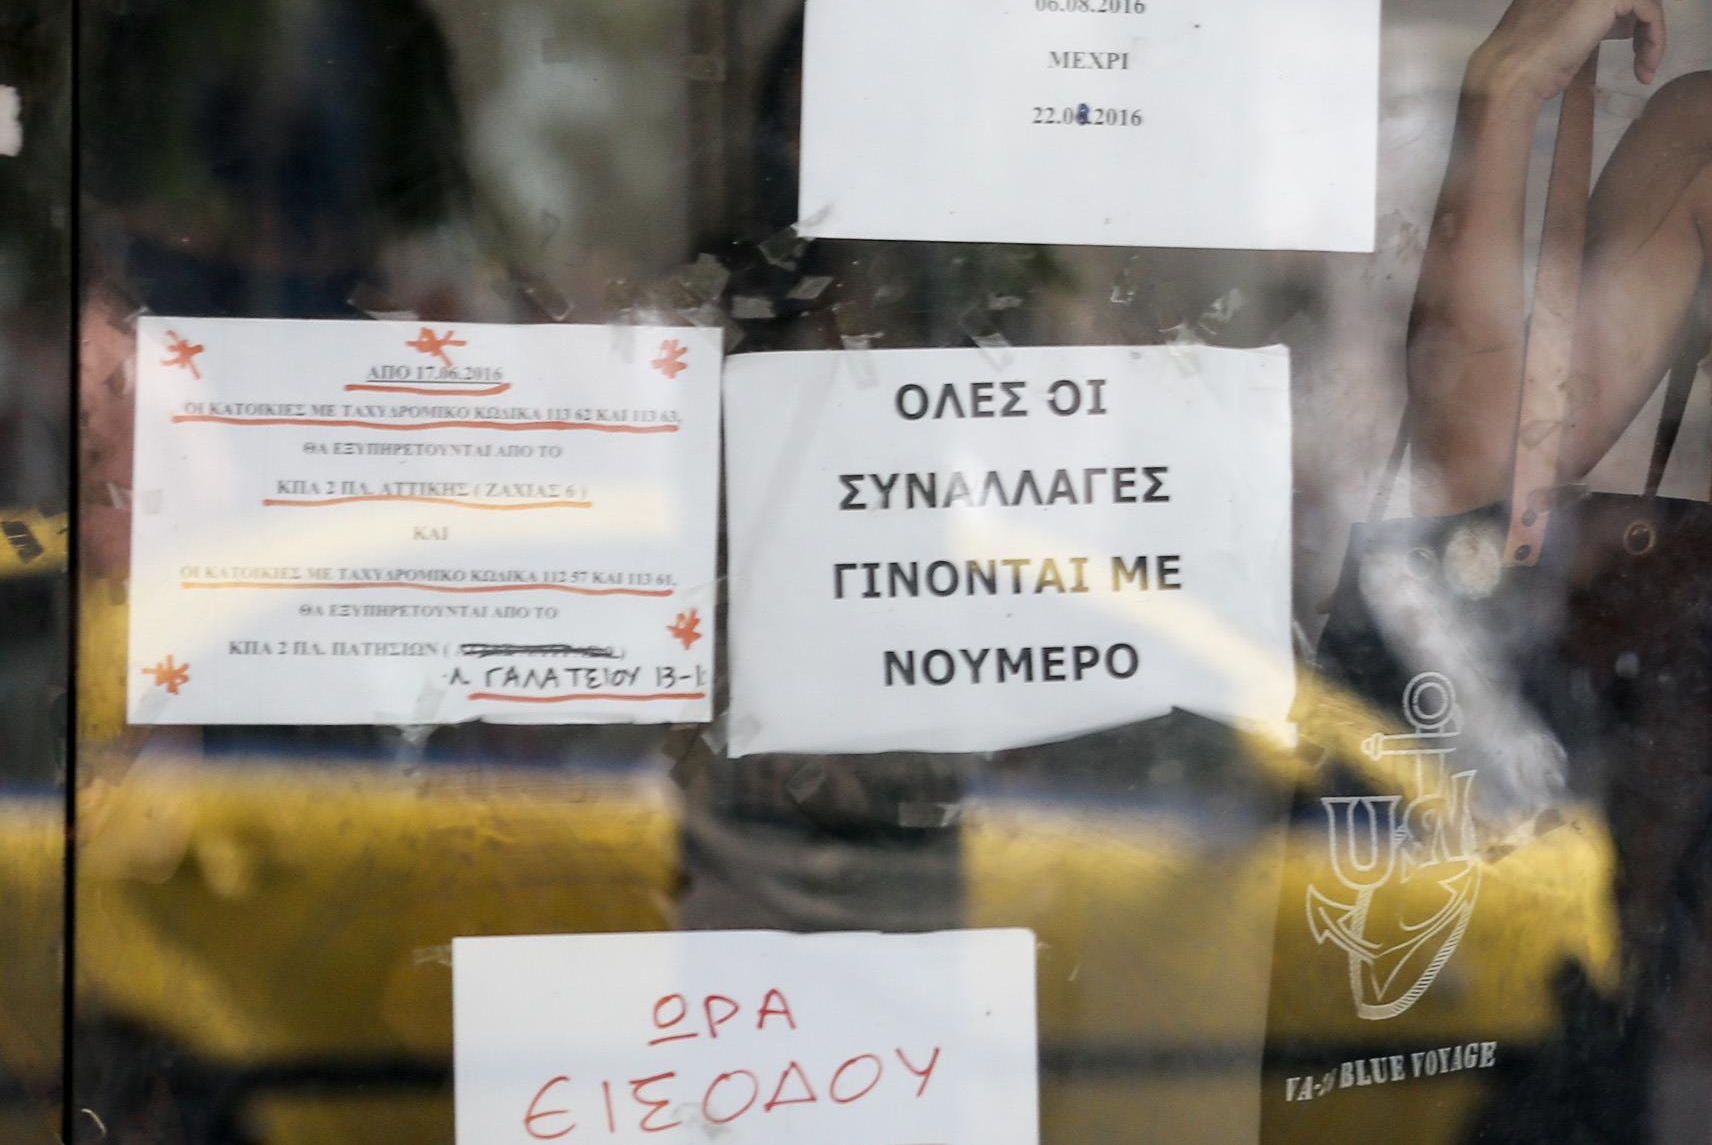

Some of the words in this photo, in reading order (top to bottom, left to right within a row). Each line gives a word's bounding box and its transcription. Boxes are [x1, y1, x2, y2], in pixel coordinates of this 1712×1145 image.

[1048, 51, 1128, 69] ΜΕΧΡΙ
[368, 365, 410, 380] ΑΠΟ
[895, 382, 1027, 420] ΟΛΕΣ
[1048, 380, 1106, 416] ΟΙ
[210, 403, 306, 416] ΚΑΤΟΙΚΙΕΣ
[312, 405, 336, 417] ΜΕ
[342, 405, 469, 418] ΤΑΧΥΔΡΟΜΙΚΟ
[596, 409, 627, 421] ΚΑΙ
[303, 442, 328, 454] ΘΑ
[333, 443, 491, 456] ΕΞΥΠΗΡΕΤΟΥΝΤΑΙ
[497, 445, 534, 457] ΑΠΟ
[538, 445, 562, 458] ΤΟ
[278, 480, 318, 494] ΚΠΑ
[327, 481, 334, 494] 2
[839, 466, 1171, 512] ΣΥΝΑΛΛΑΓΕΣ
[414, 527, 448, 540] ΚΑΙ
[308, 568, 333, 580] ΜΕ
[341, 569, 466, 584] ΤΑΧΥΔΡΟΜΙΚΟ
[592, 572, 622, 584] ΚΑΙ
[833, 557, 1090, 600] ΓΙΝΟΝΤΑΙ
[1110, 555, 1183, 592] ΜΕ
[299, 605, 323, 616] ΘΑ
[330, 605, 487, 617] ΕΞΥΠΗΡΕΤΟΥΝΤΑΙ
[495, 606, 530, 618] ΑΠΟ
[534, 607, 558, 619] ΤΟ
[229, 641, 272, 655] ΚΠΑ
[279, 642, 286, 654] 2
[333, 642, 437, 656] ΠΑΤΗΣΙΩΝ
[884, 642, 1140, 688] ΝΟΥΜΕΡΟ
[1339, 1055, 1406, 1089] BLUE
[1411, 1041, 1497, 1078] VOYAGE
[523, 1046, 941, 1140] ΕΙΣΟΔΟΥ
